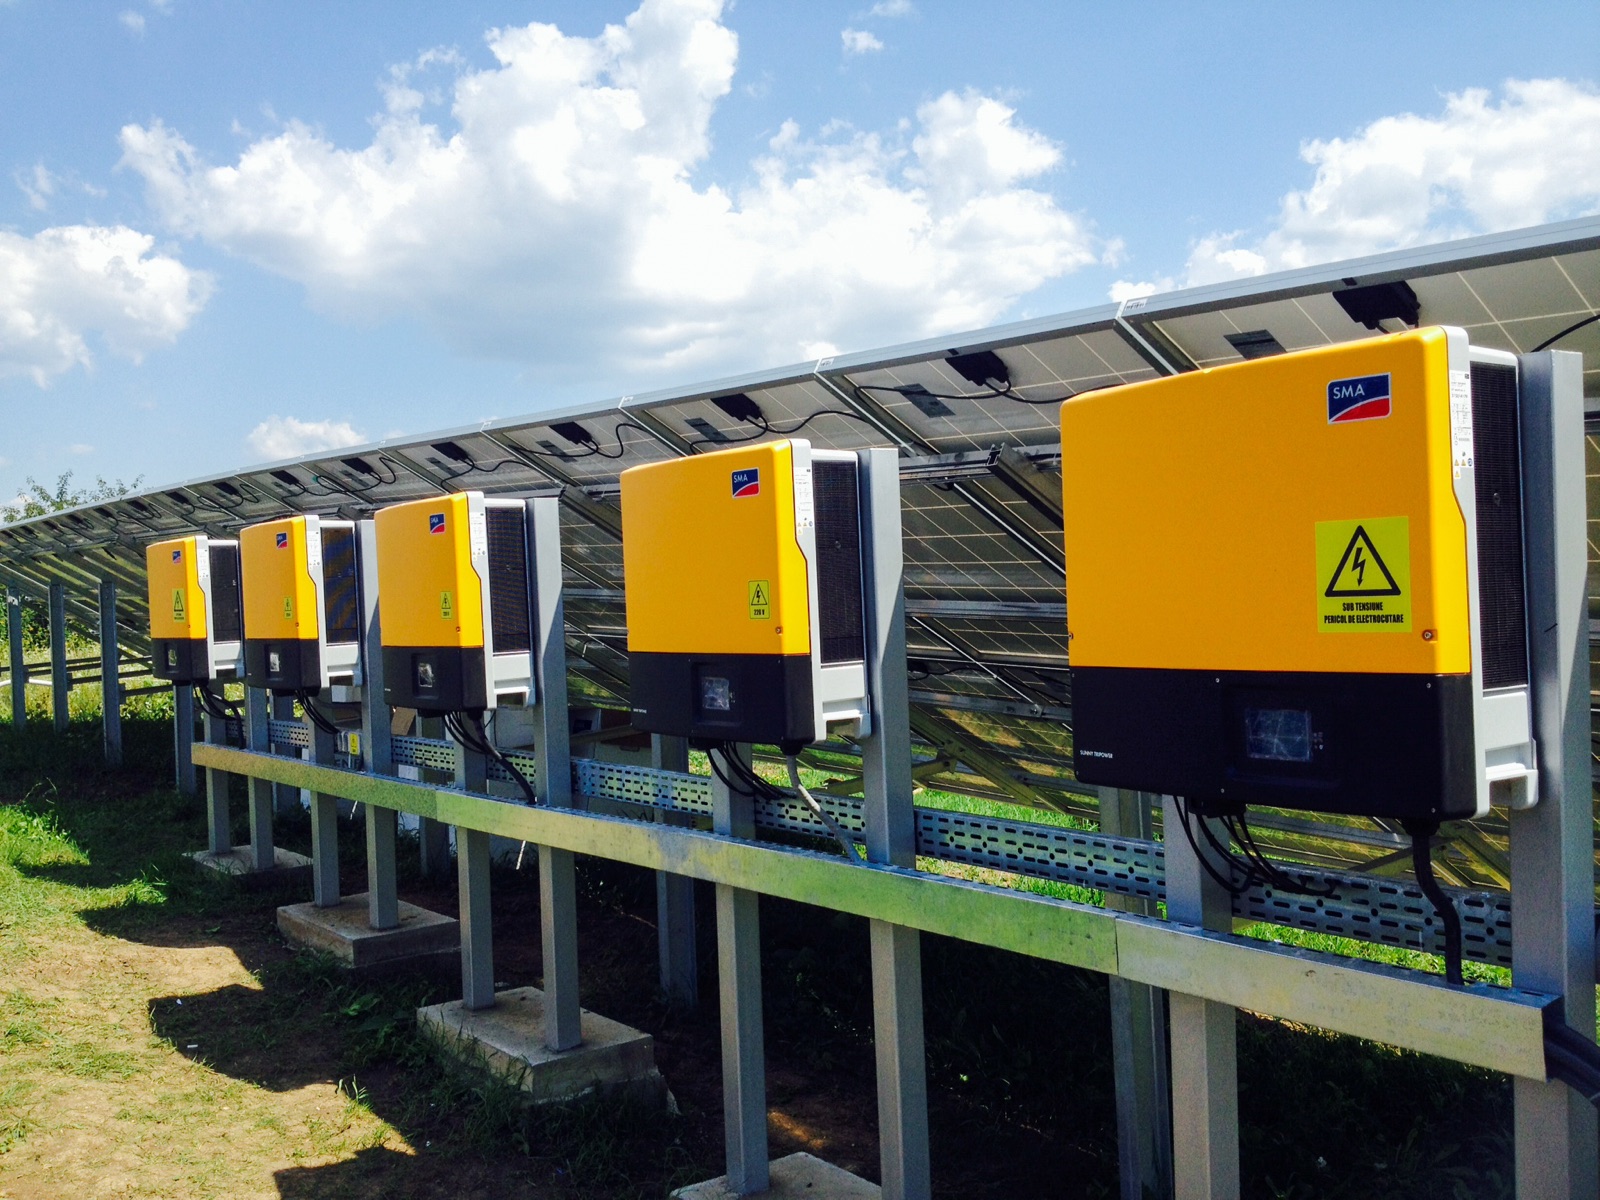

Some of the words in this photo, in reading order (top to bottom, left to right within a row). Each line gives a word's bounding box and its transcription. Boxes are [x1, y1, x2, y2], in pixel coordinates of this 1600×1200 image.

[1333, 384, 1365, 399] SMA
[733, 473, 748, 483] SMA
[1342, 602, 1354, 612] SUB
[1355, 602, 1384, 611] TENSIUNE
[1324, 615, 1347, 624] PERICOL
[1348, 615, 1355, 623] DE
[1356, 614, 1404, 623] ELECTROCUTARE
